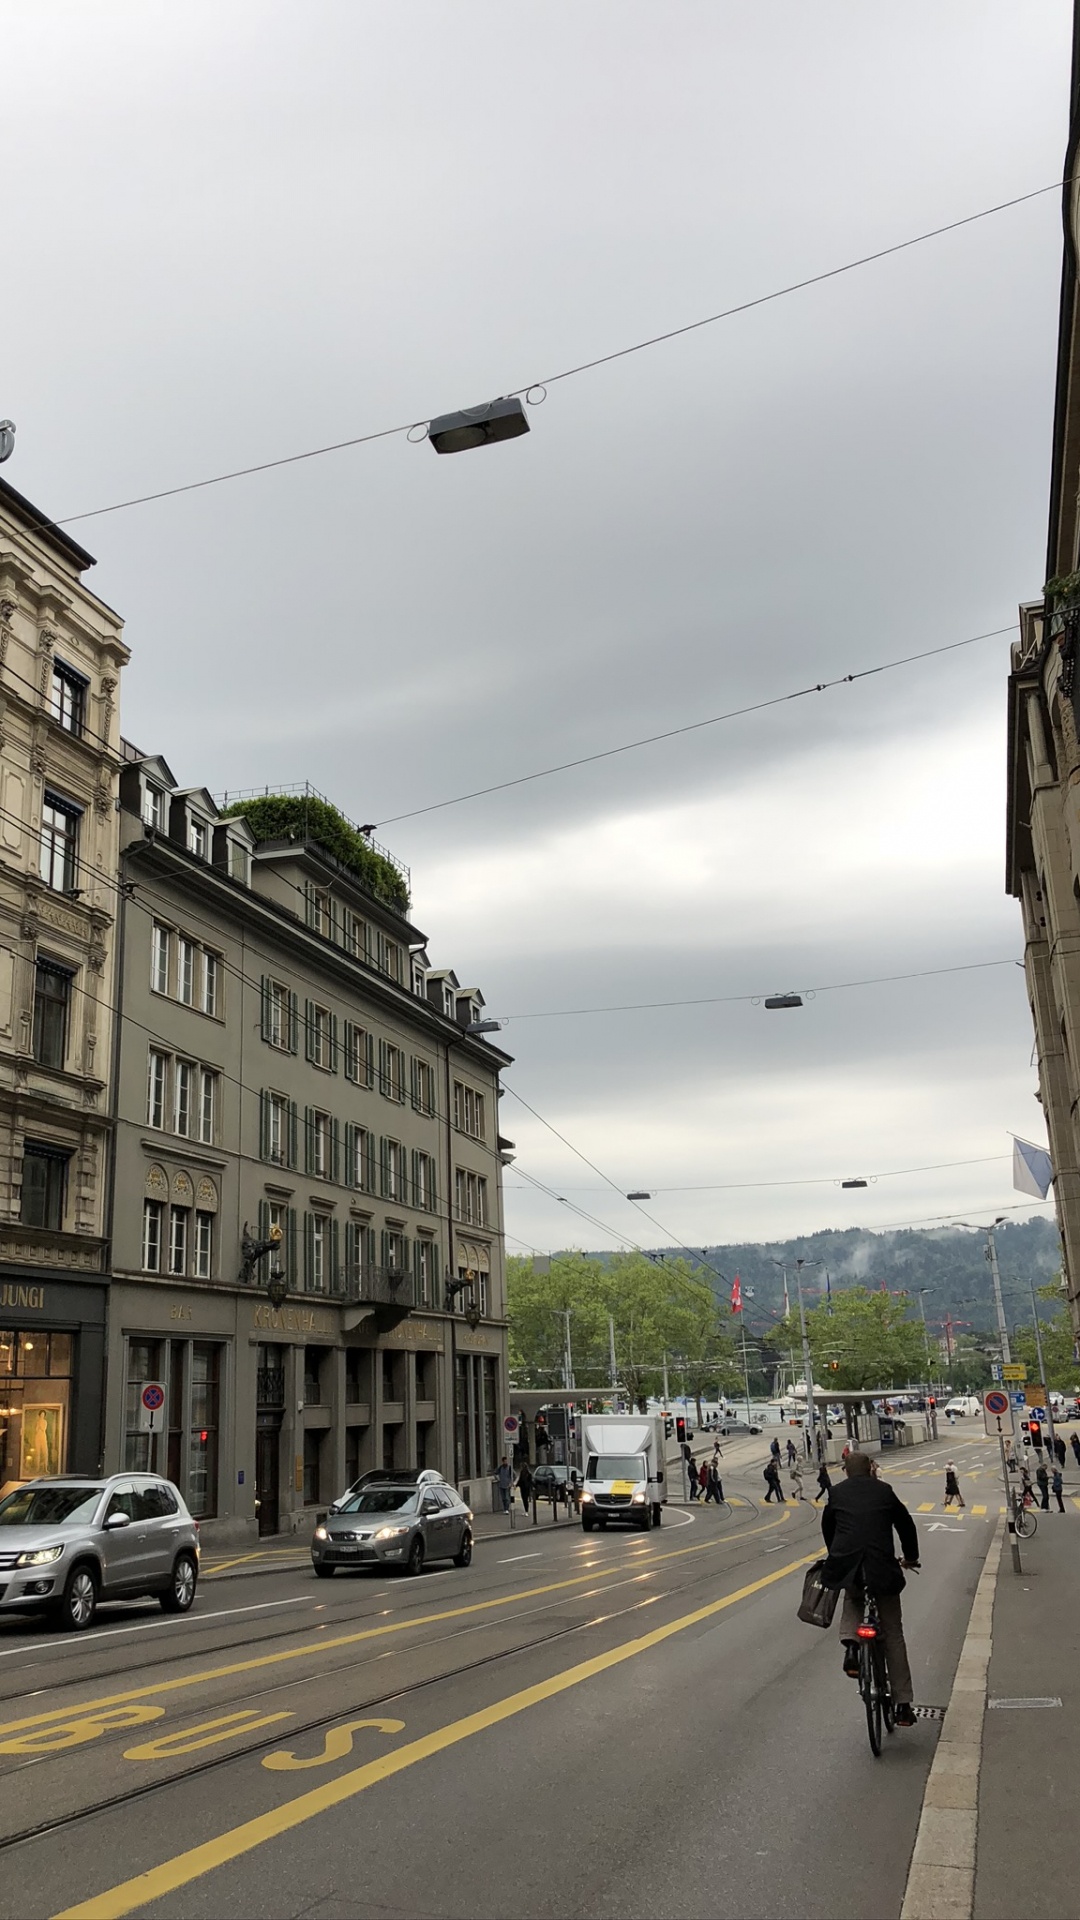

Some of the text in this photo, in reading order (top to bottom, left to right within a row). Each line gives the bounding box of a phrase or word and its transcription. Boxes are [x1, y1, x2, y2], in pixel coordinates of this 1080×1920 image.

[0, 1284, 44, 1309] JUNGI
[170, 1303, 192, 1320] BAR
[253, 1304, 334, 1335] KRONENHALLE
[0, 1705, 406, 1770] BUS
